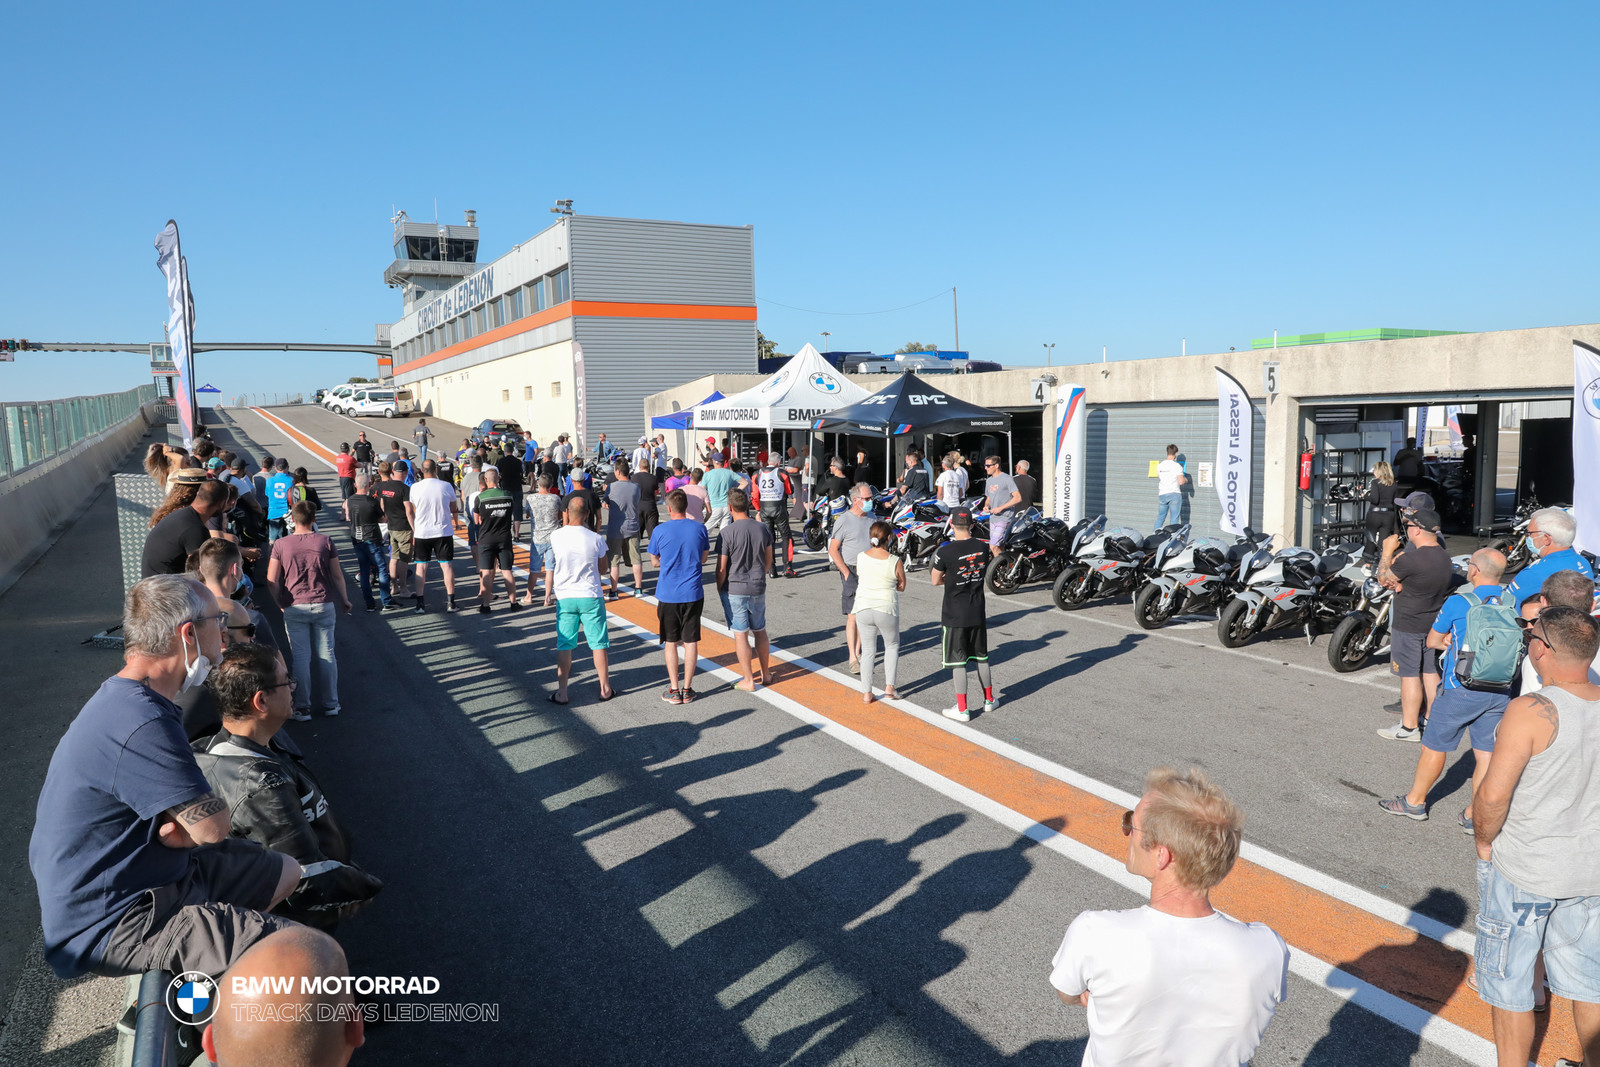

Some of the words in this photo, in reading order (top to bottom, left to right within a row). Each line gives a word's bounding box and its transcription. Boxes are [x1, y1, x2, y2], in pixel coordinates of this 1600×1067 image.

[417, 298, 442, 334] CIRCUIT
[443, 294, 452, 321] de
[453, 266, 494, 316] LEDENON
[1268, 367, 1275, 392] 5
[908, 395, 948, 406] BMC
[1035, 383, 1044, 403] 4
[700, 409, 717, 421] BMW
[718, 408, 760, 421] MOTORRAD
[762, 479, 775, 488] 23
[1064, 454, 1072, 500] MOTORRAD
[1512, 902, 1551, 927] 75
